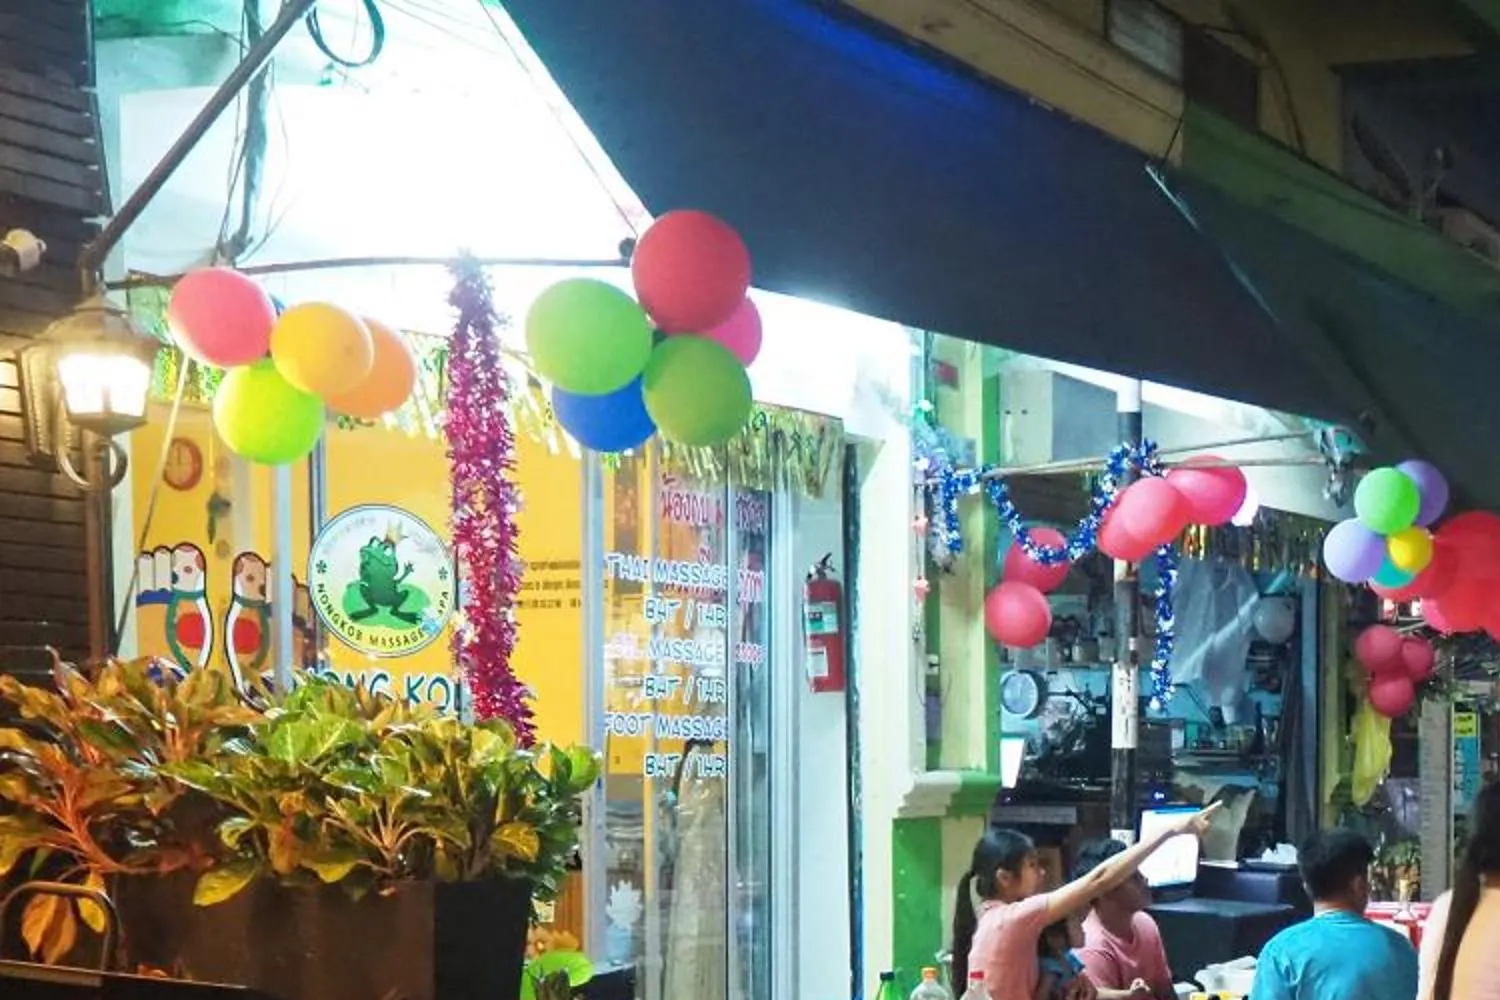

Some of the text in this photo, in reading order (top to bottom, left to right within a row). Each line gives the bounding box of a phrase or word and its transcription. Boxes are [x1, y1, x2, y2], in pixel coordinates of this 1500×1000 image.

[368, 628, 425, 649] MASSAGE
[649, 638, 725, 664] MASSAGE
[405, 674, 462, 712] KO
[604, 713, 652, 735] FOOT
